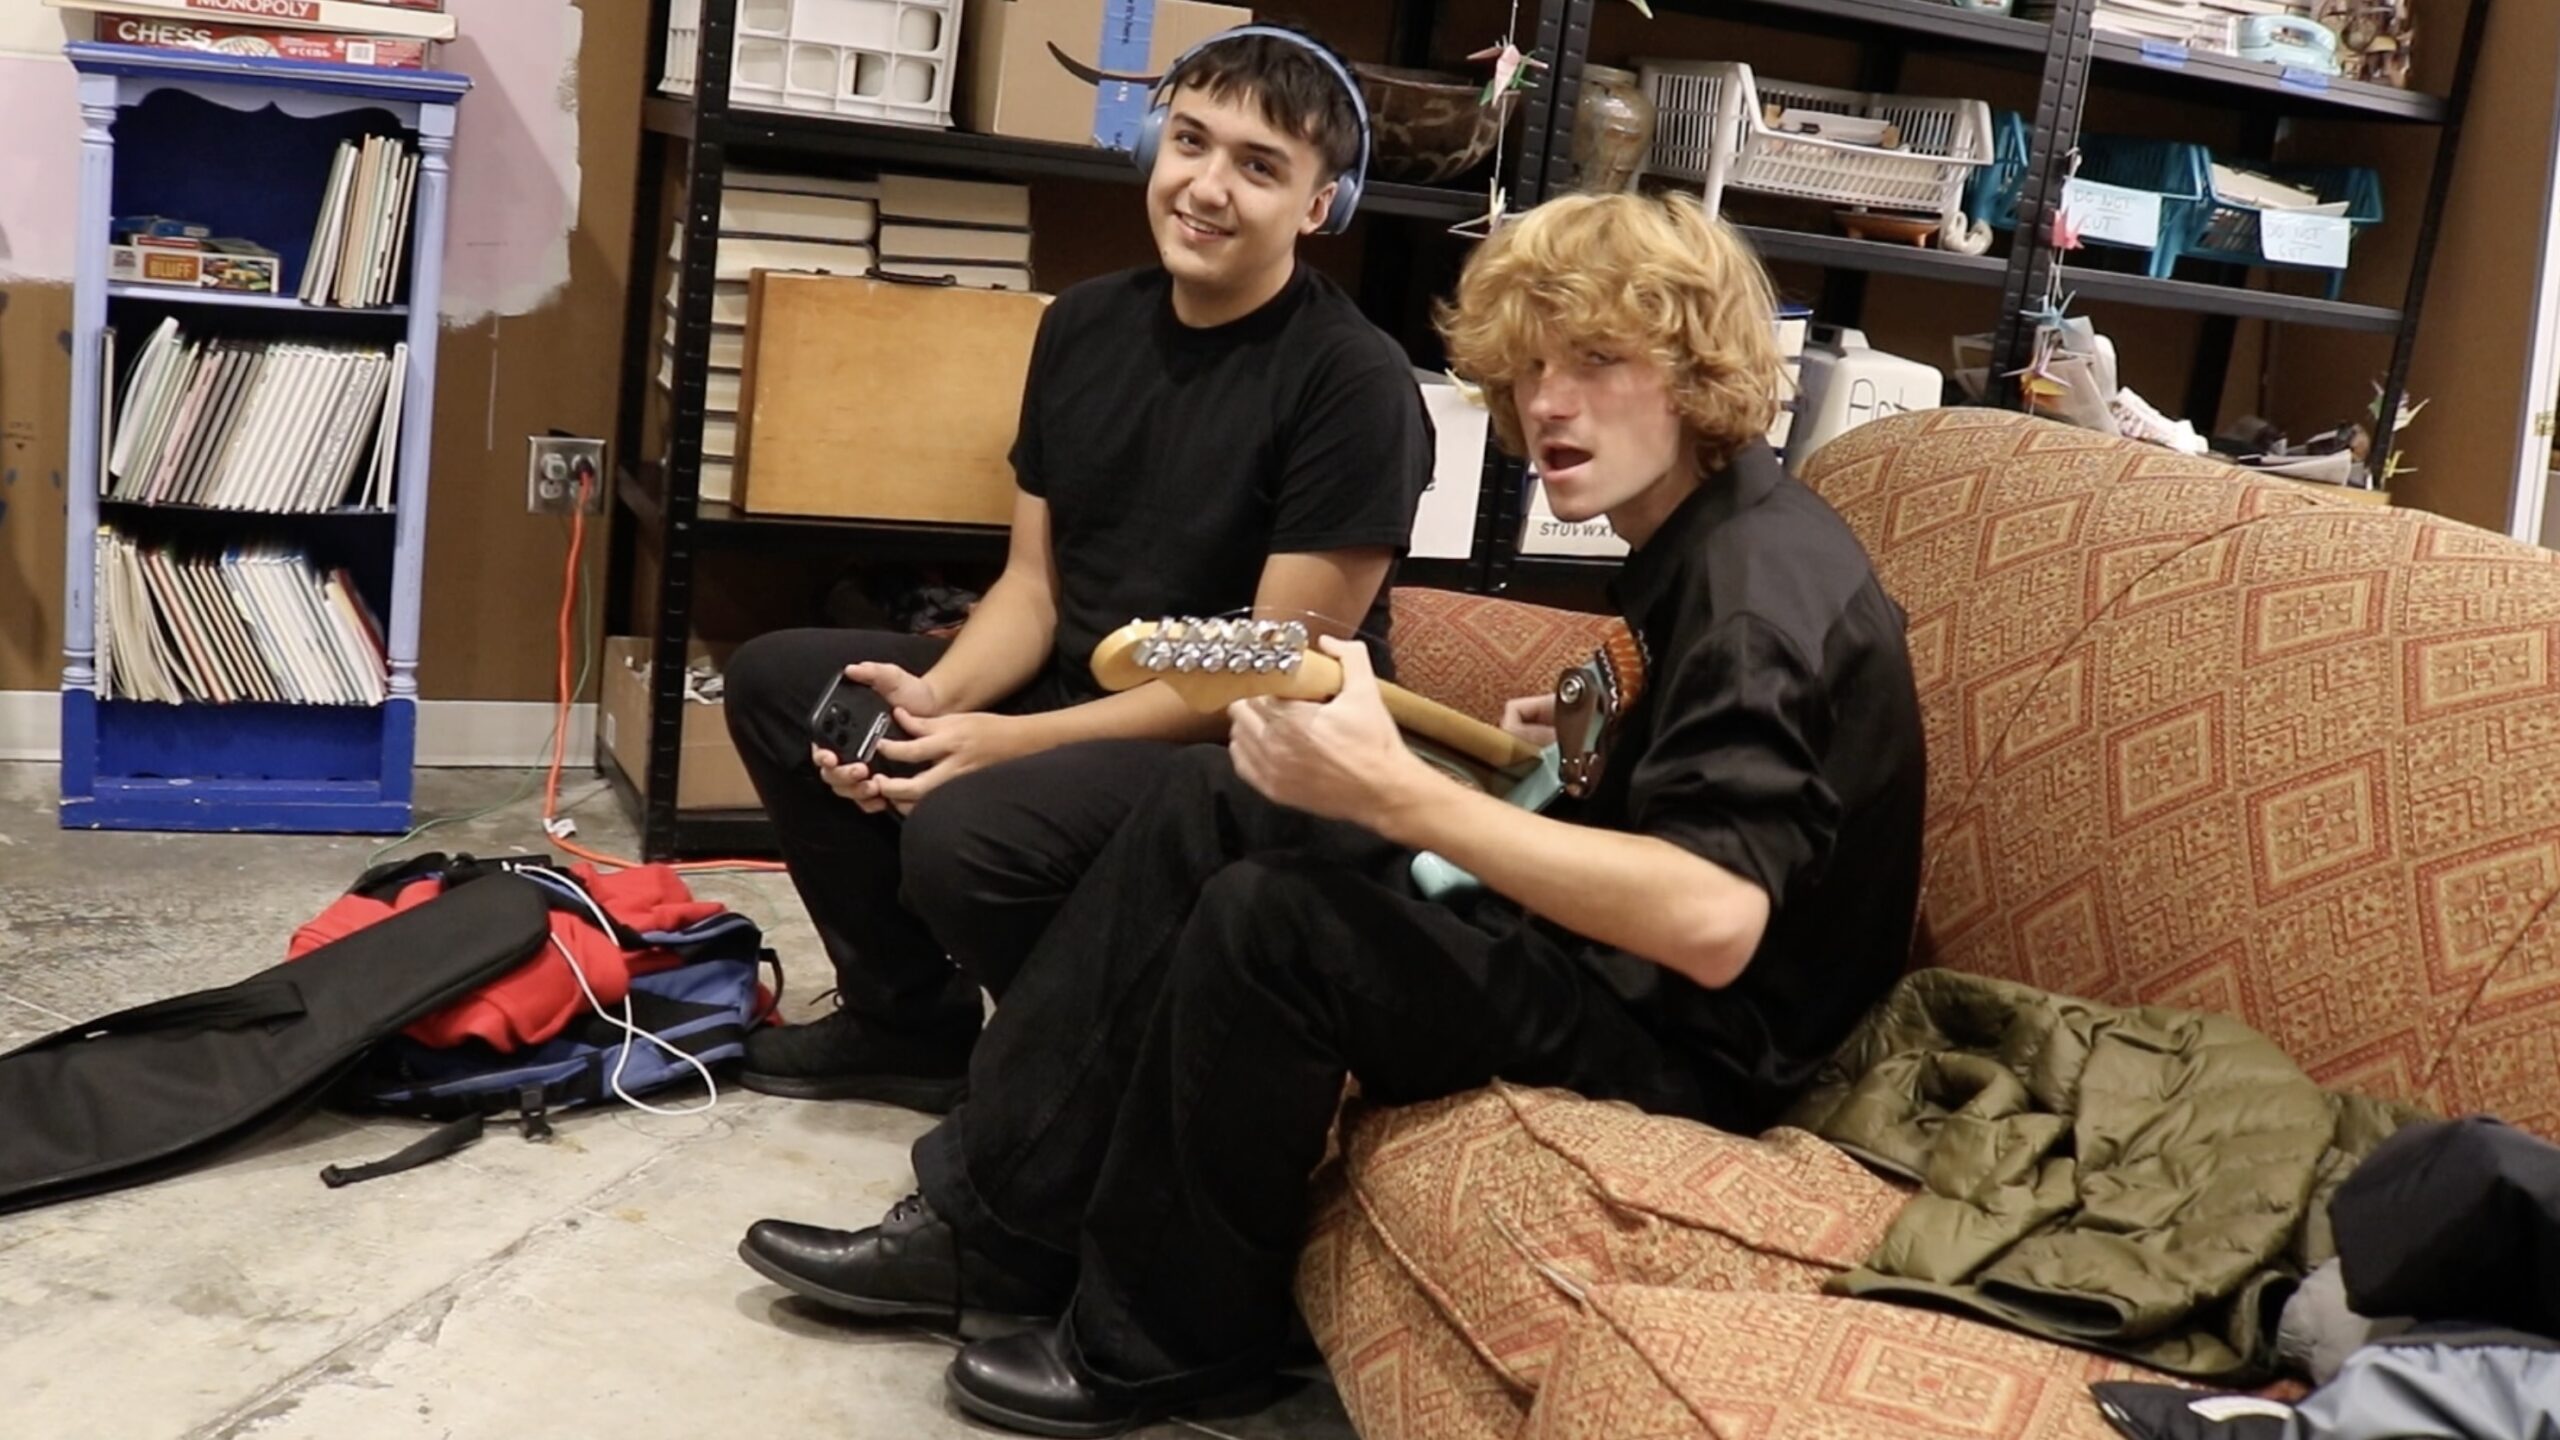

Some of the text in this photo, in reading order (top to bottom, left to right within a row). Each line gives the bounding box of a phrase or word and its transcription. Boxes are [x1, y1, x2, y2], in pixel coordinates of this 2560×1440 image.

[117, 20, 213, 45] CHESS
[2074, 188, 2094, 203] DO
[150, 260, 193, 279] BLUFF
